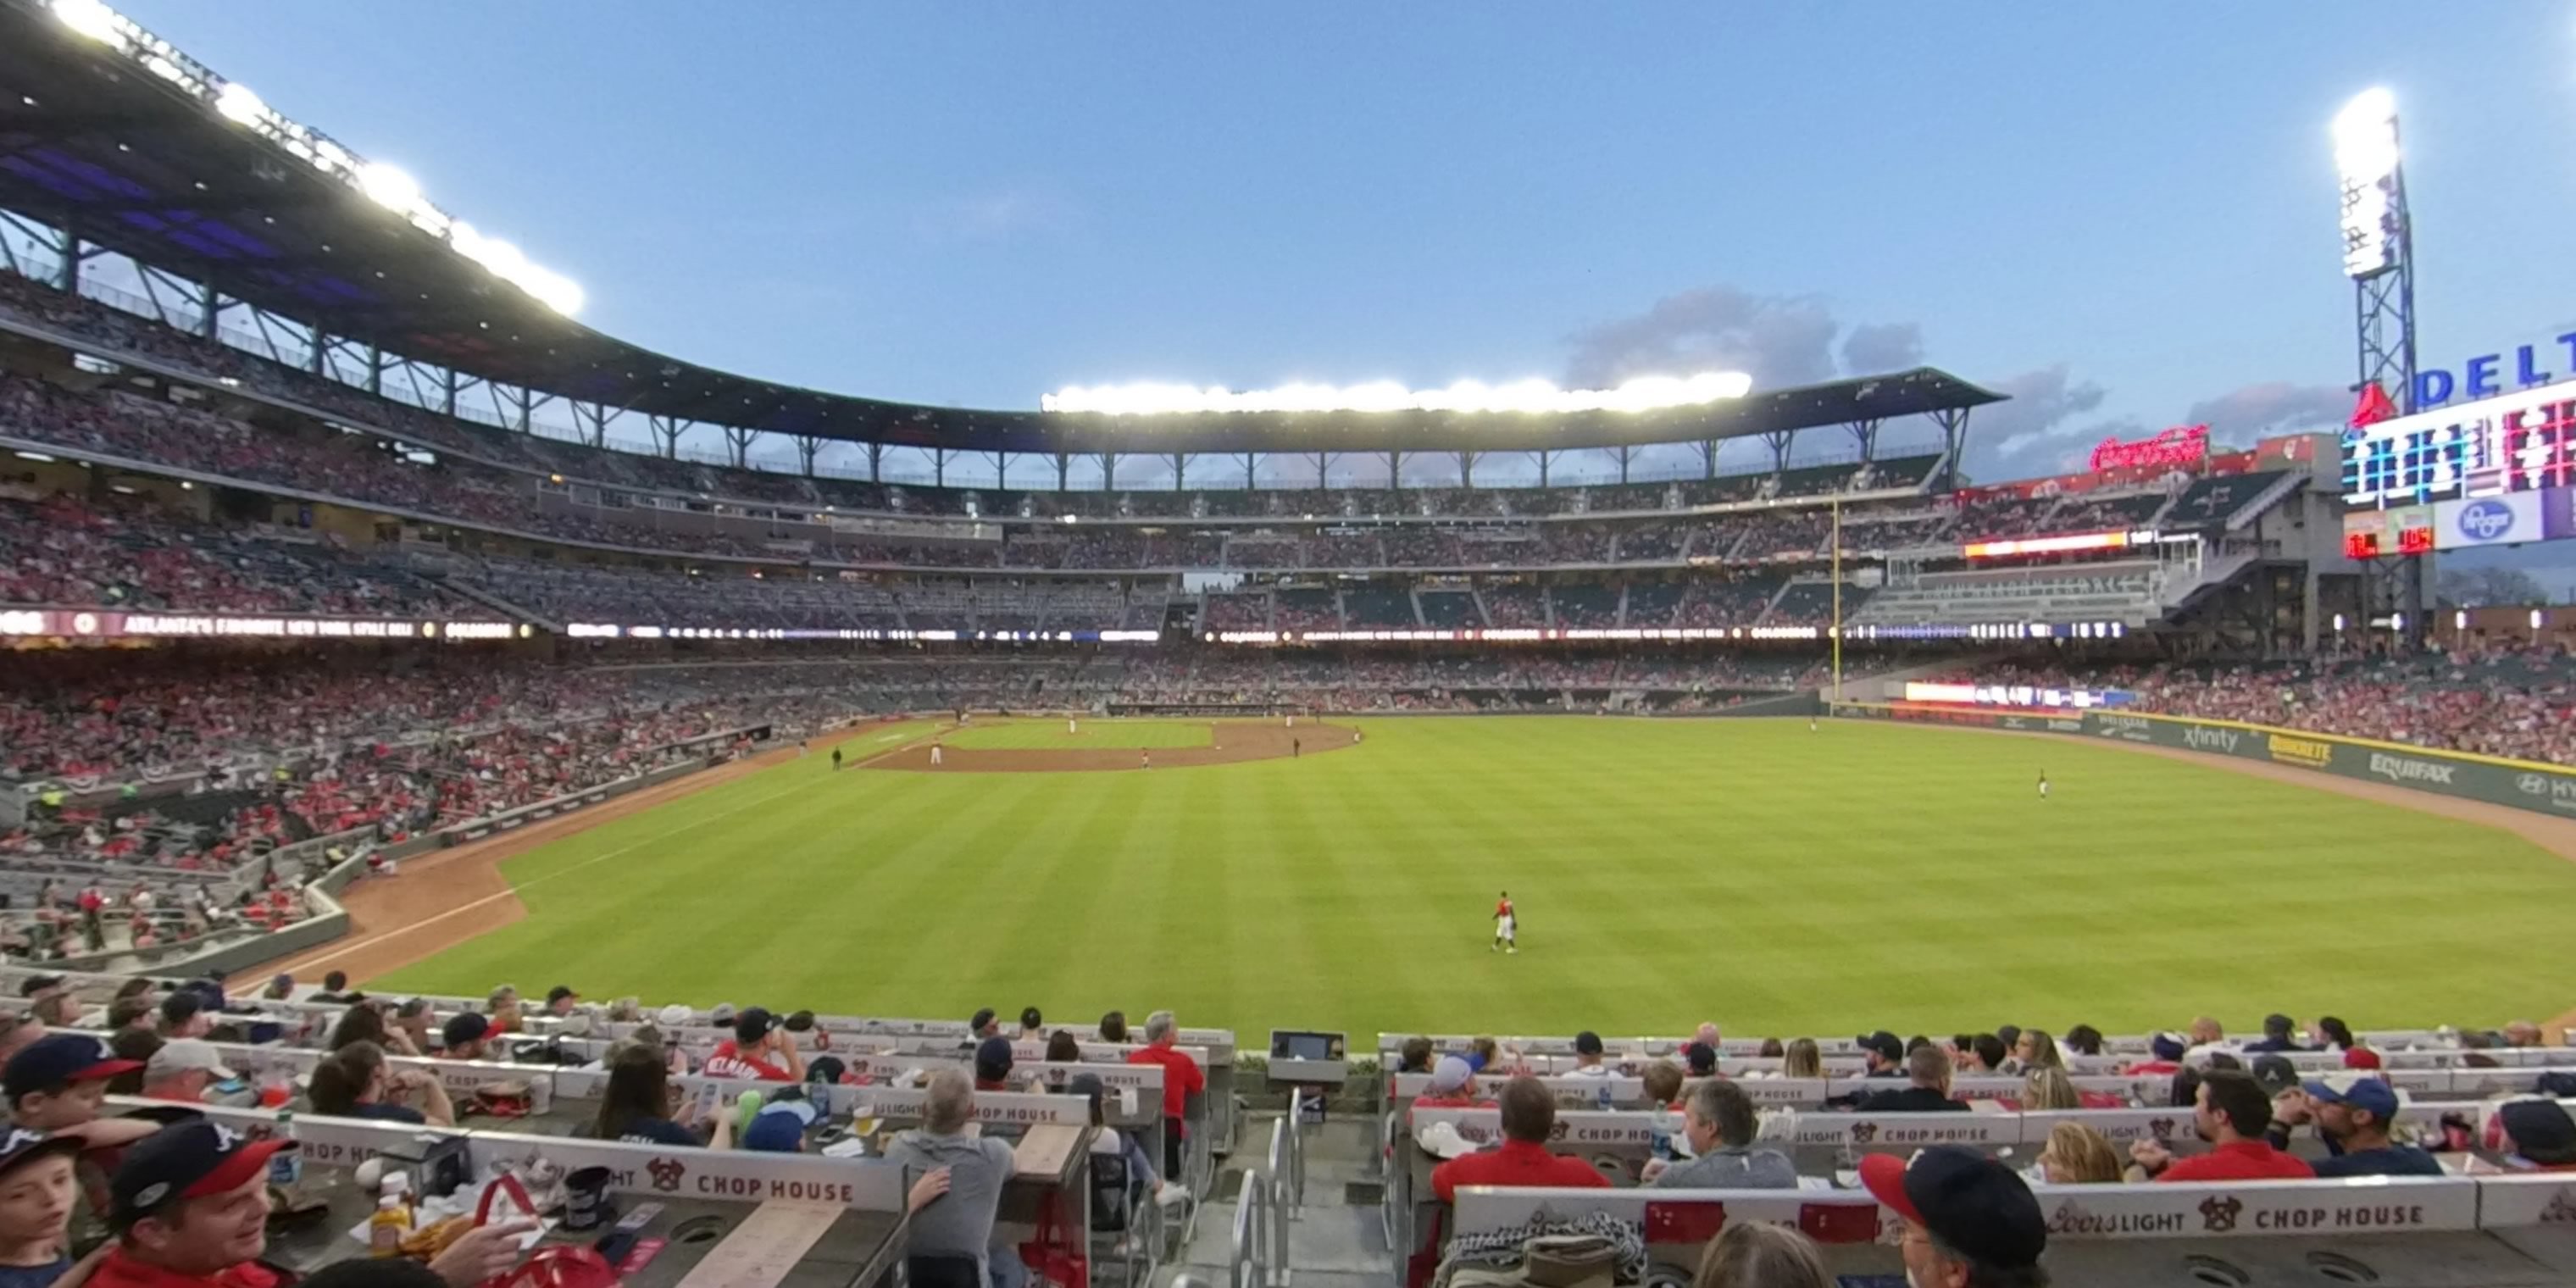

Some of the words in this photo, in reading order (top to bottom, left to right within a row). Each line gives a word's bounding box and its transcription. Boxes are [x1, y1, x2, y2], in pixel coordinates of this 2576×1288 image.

[2183, 724, 2239, 752] xfinity
[2370, 752, 2455, 784] EQUIFAX
[1006, 1107, 1058, 1121] HOUSE
[1579, 1129, 1622, 1141] CHOP
[1885, 1130, 1929, 1141] CHOP
[1935, 1129, 1989, 1141] HOUSE
[303, 1143, 343, 1160] HOP
[697, 1175, 762, 1196] CHOP
[770, 1180, 854, 1202] HOUSE
[2121, 1213, 2185, 1231] LIGHT
[2255, 1209, 2327, 1229] CHOP
[2335, 1206, 2424, 1226] HOUSE
